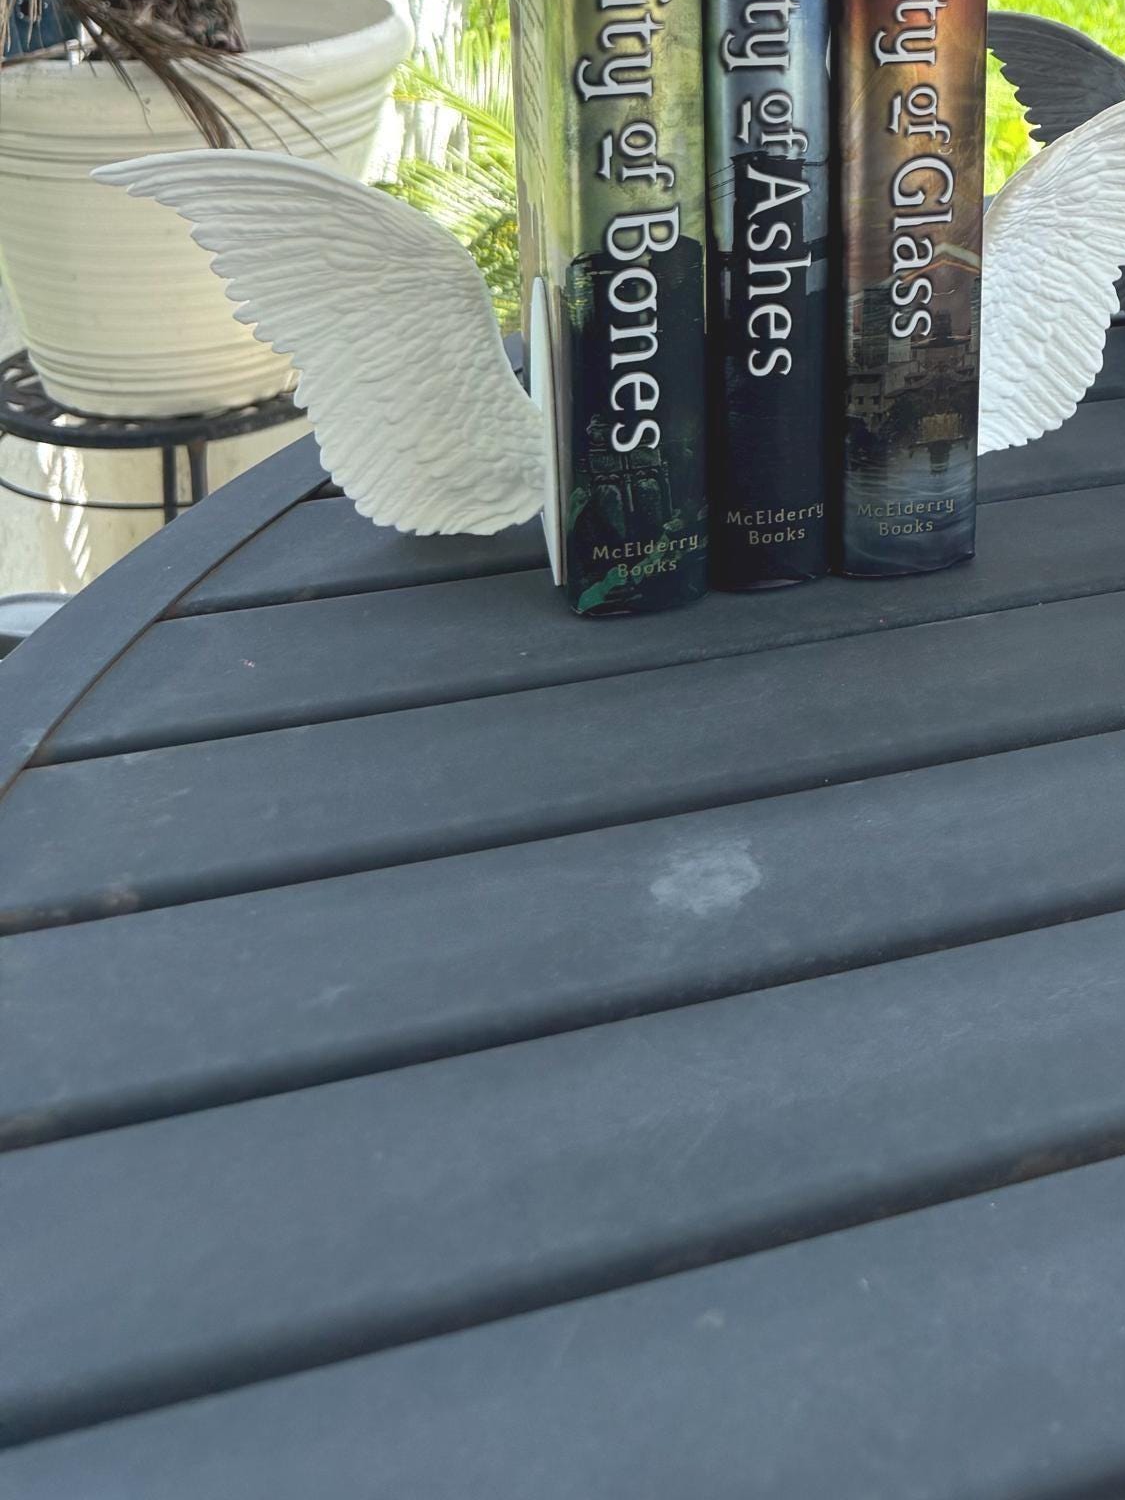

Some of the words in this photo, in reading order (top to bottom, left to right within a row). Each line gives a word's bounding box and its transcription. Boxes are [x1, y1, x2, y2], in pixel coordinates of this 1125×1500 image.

[761, 92, 808, 154] of
[908, 87, 950, 143] of
[621, 122, 674, 188] of
[890, 155, 956, 339] Glass
[746, 164, 813, 378] Ashes
[605, 206, 681, 453] Bones
[726, 501, 824, 526] McElderry
[855, 498, 955, 518] McElderry
[878, 518, 934, 537] Books
[591, 532, 699, 560] McElderry
[748, 525, 806, 546] Books
[616, 557, 678, 580] Books
